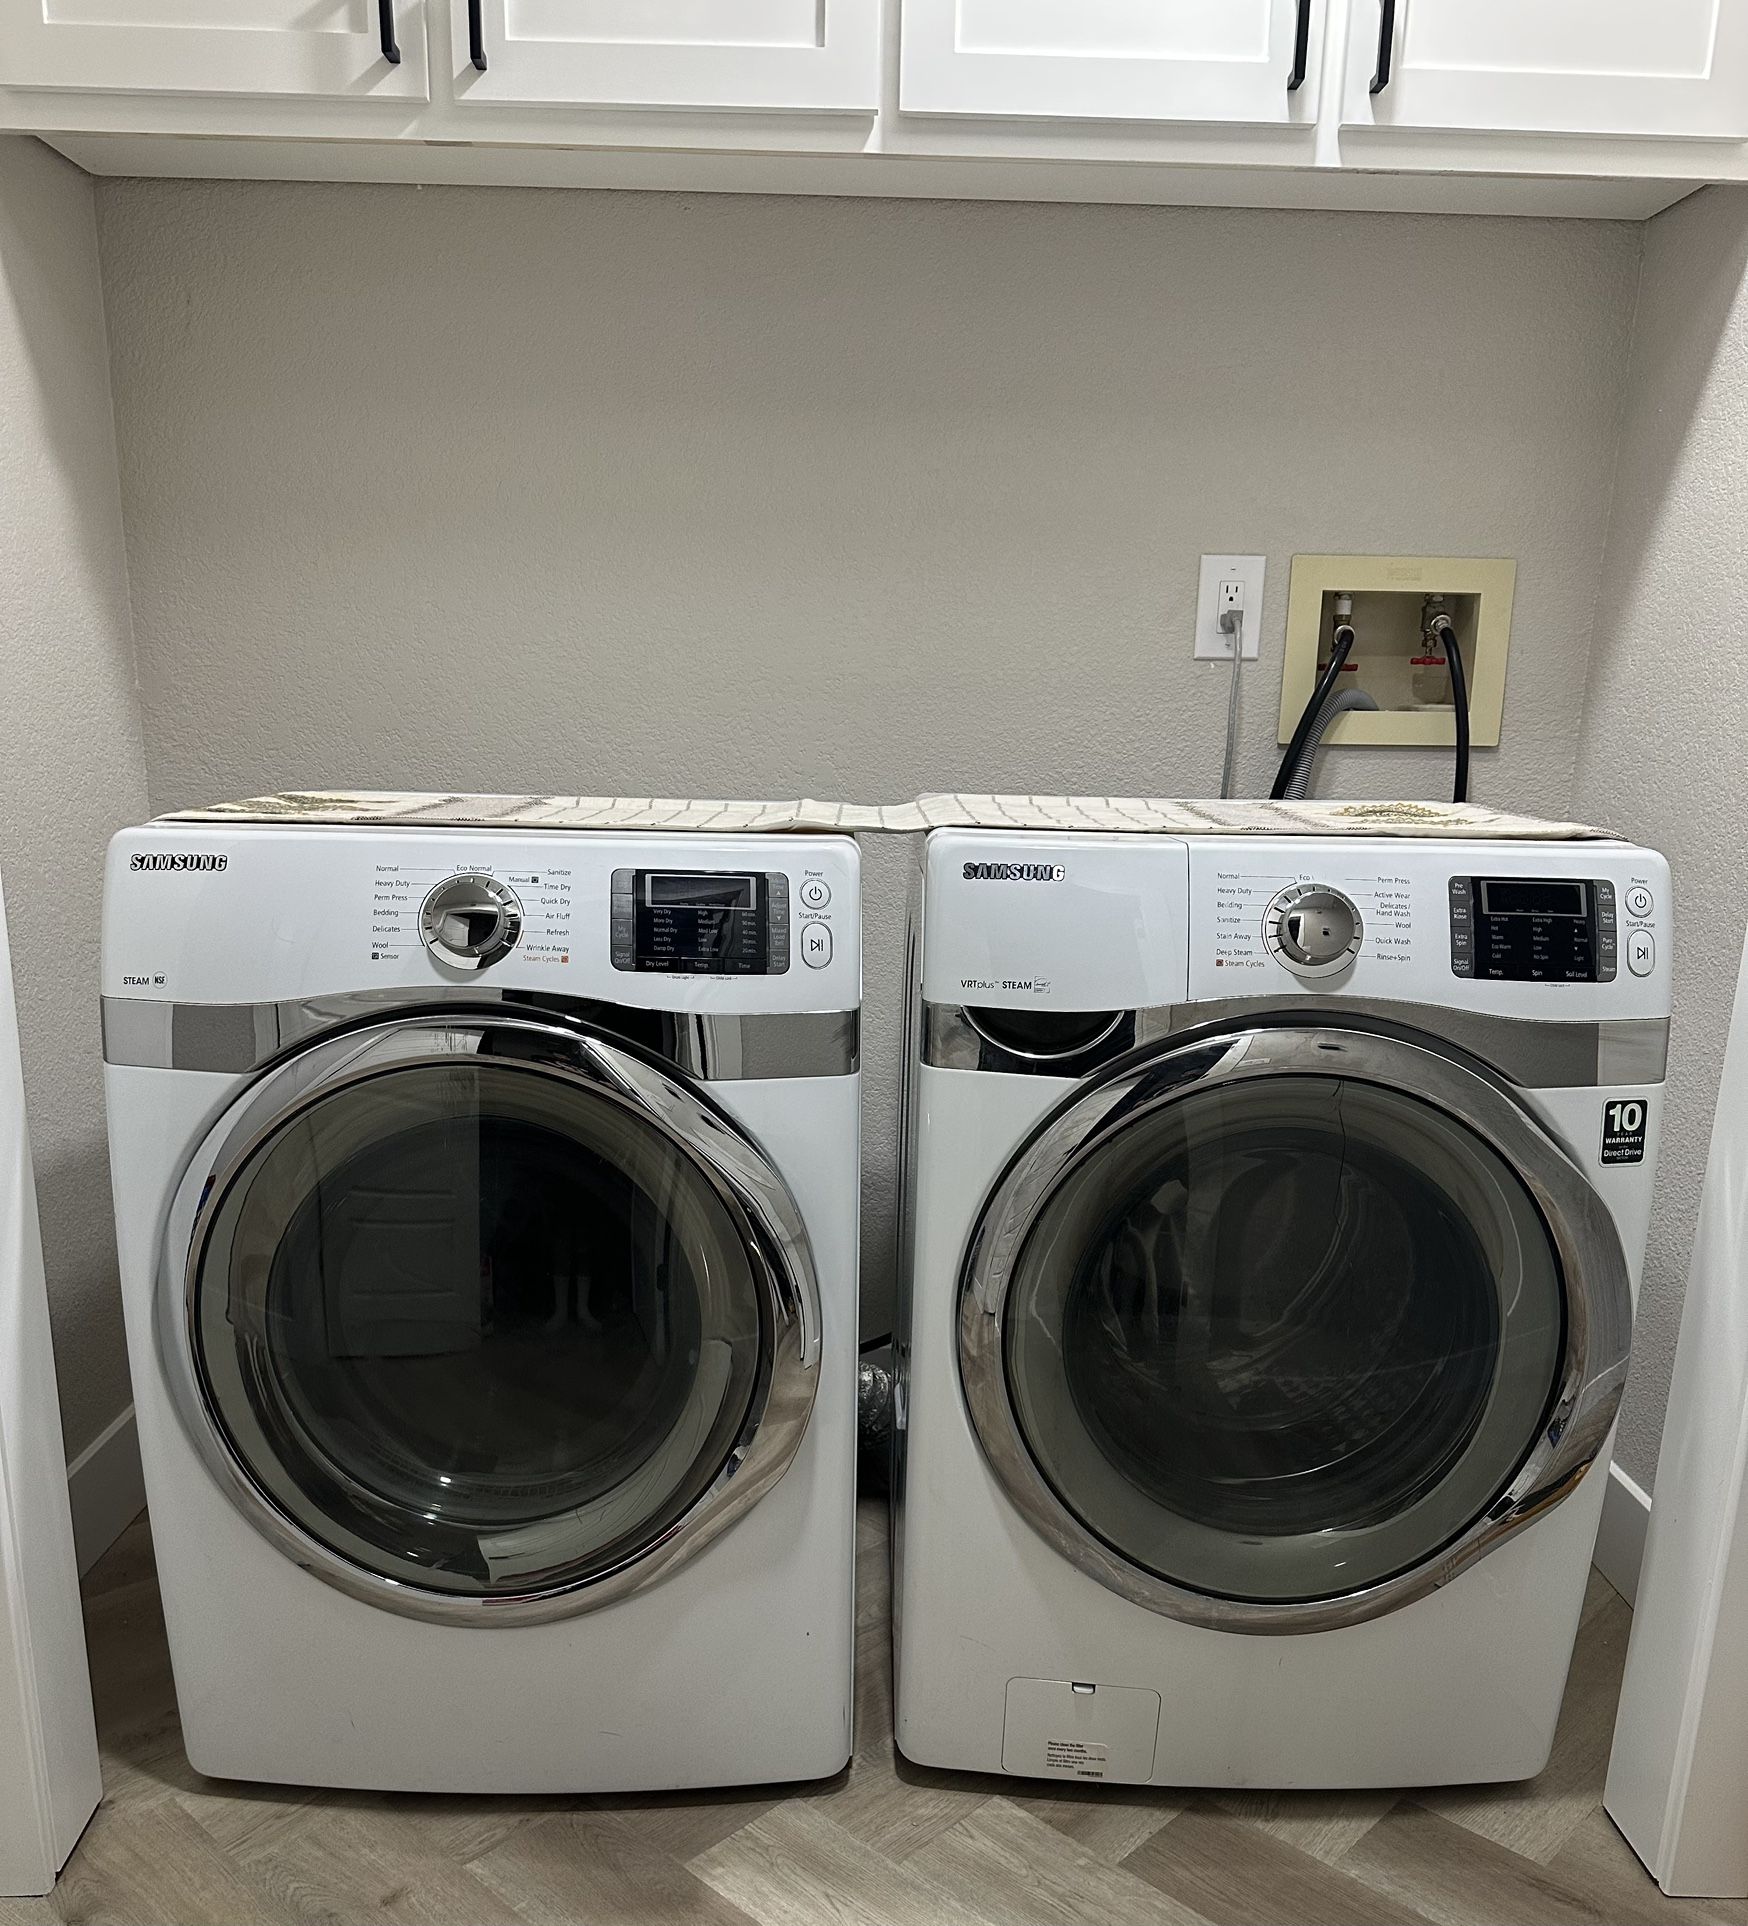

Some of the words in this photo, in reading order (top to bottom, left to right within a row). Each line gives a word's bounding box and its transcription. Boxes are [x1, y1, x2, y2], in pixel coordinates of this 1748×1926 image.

[130, 854, 228, 871] SAMSUNG
[963, 862, 1065, 882] SAMSUNG
[1376, 954, 1410, 962] Rinse+Spin
[123, 976, 149, 985] STEAM
[154, 976, 165, 984] NSF
[1002, 981, 1032, 990] STEAM
[1609, 1103, 1642, 1132] 10
